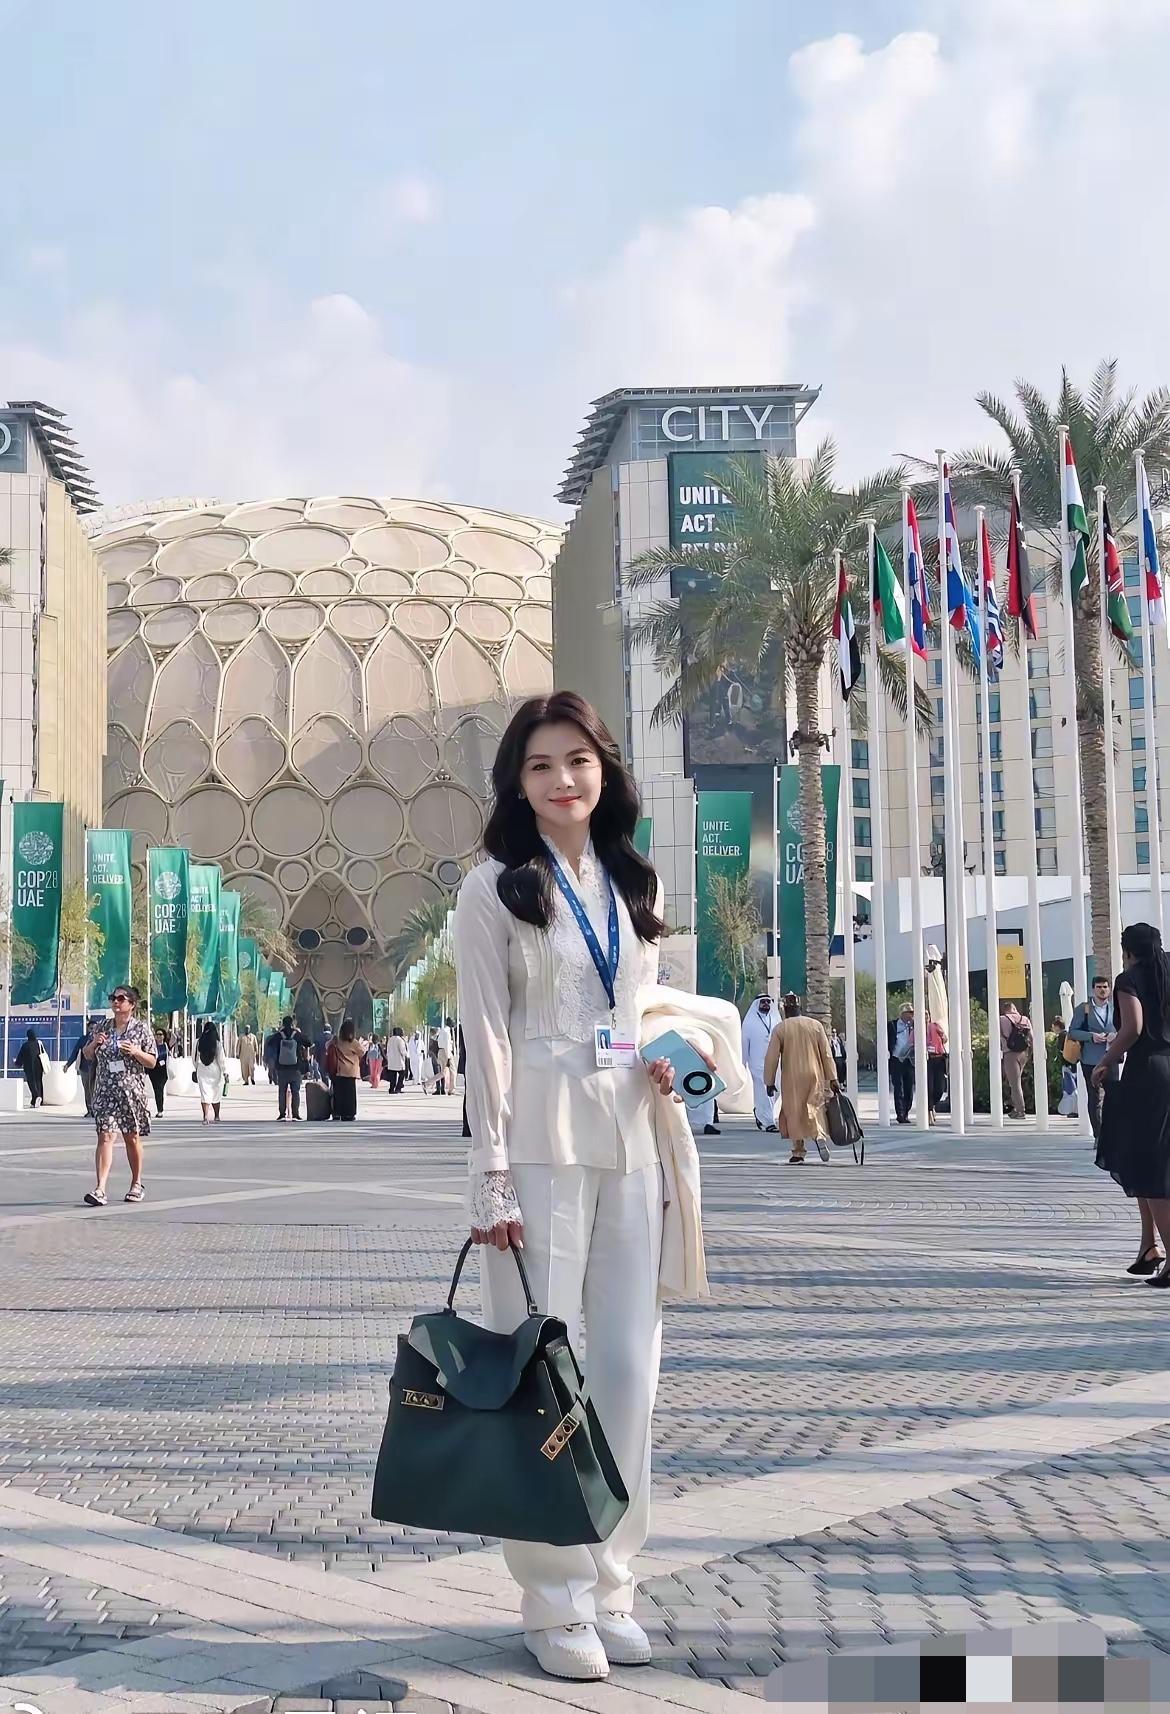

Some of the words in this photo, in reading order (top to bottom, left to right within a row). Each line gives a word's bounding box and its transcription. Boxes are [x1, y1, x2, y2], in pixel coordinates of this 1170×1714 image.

[661, 405, 775, 442] CITY
[702, 821, 732, 831] UNITE.
[702, 833, 722, 844] ACT.
[702, 845, 743, 857] DELIVER.
[17, 870, 58, 889] COP28
[17, 889, 45, 907] UAE
[154, 919, 176, 934] UAE
